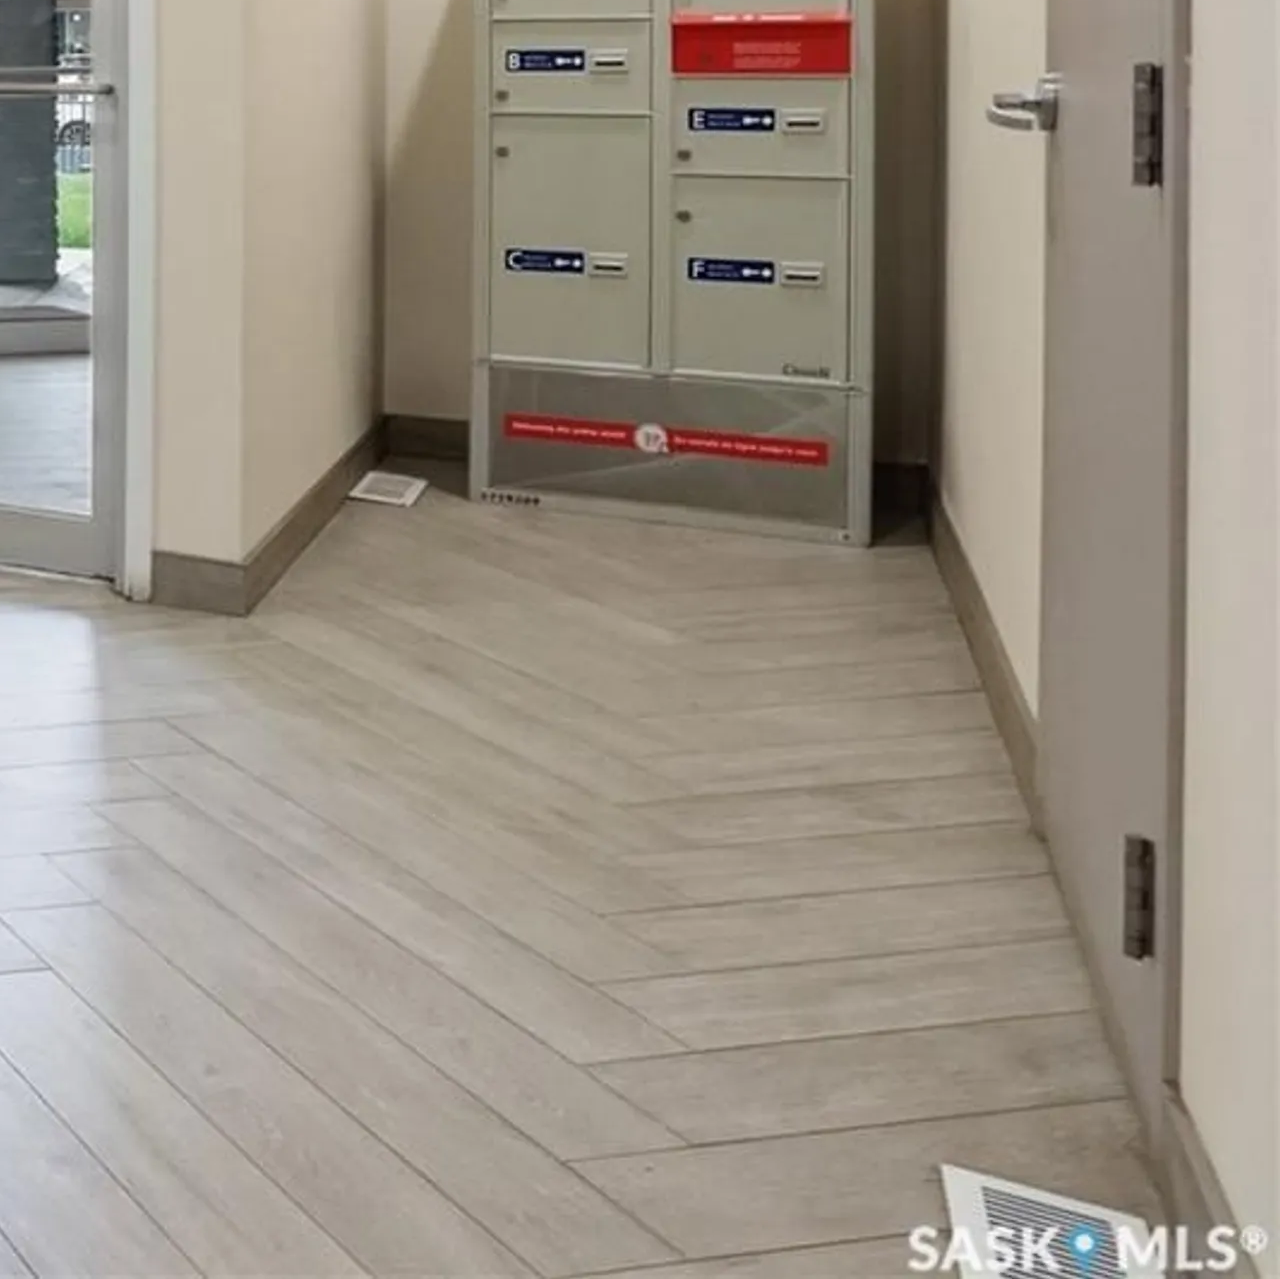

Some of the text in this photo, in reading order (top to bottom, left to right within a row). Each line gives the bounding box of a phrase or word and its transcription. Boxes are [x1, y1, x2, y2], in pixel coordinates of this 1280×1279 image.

[508, 52, 520, 69] B
[692, 110, 705, 128] E
[508, 252, 523, 269] C
[692, 261, 705, 277] F
